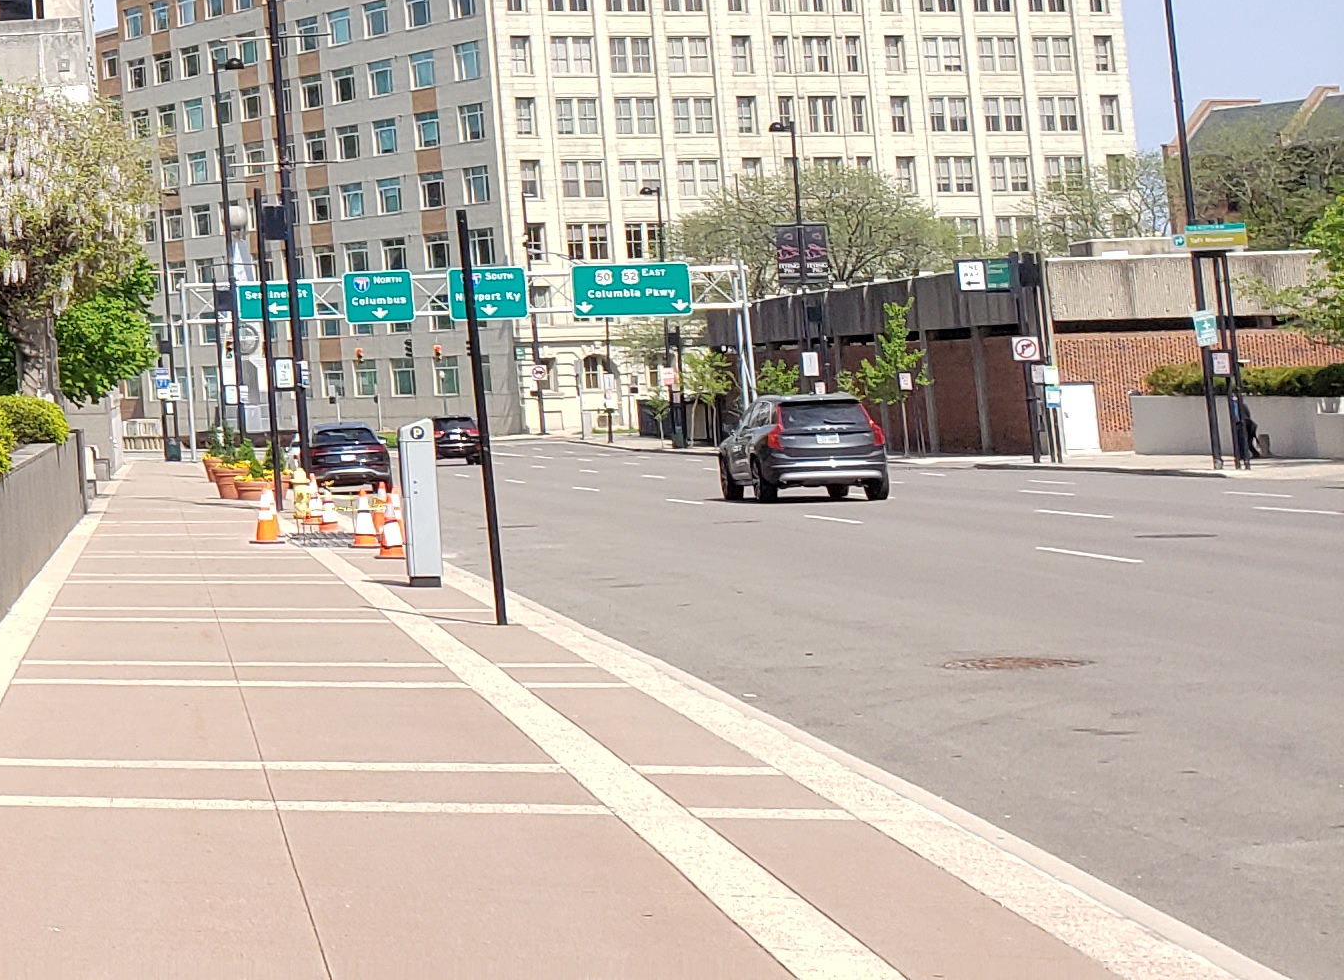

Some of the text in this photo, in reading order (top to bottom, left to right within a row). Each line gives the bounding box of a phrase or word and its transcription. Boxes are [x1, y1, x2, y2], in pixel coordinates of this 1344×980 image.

[484, 272, 514, 281] SOUTH
[597, 268, 666, 281] 50 52 EAST
[355, 276, 403, 291] 71 NORTH
[454, 291, 522, 304] Nport Ky
[587, 288, 676, 299] Columbia Pkwy
[351, 296, 407, 306] Columbus
